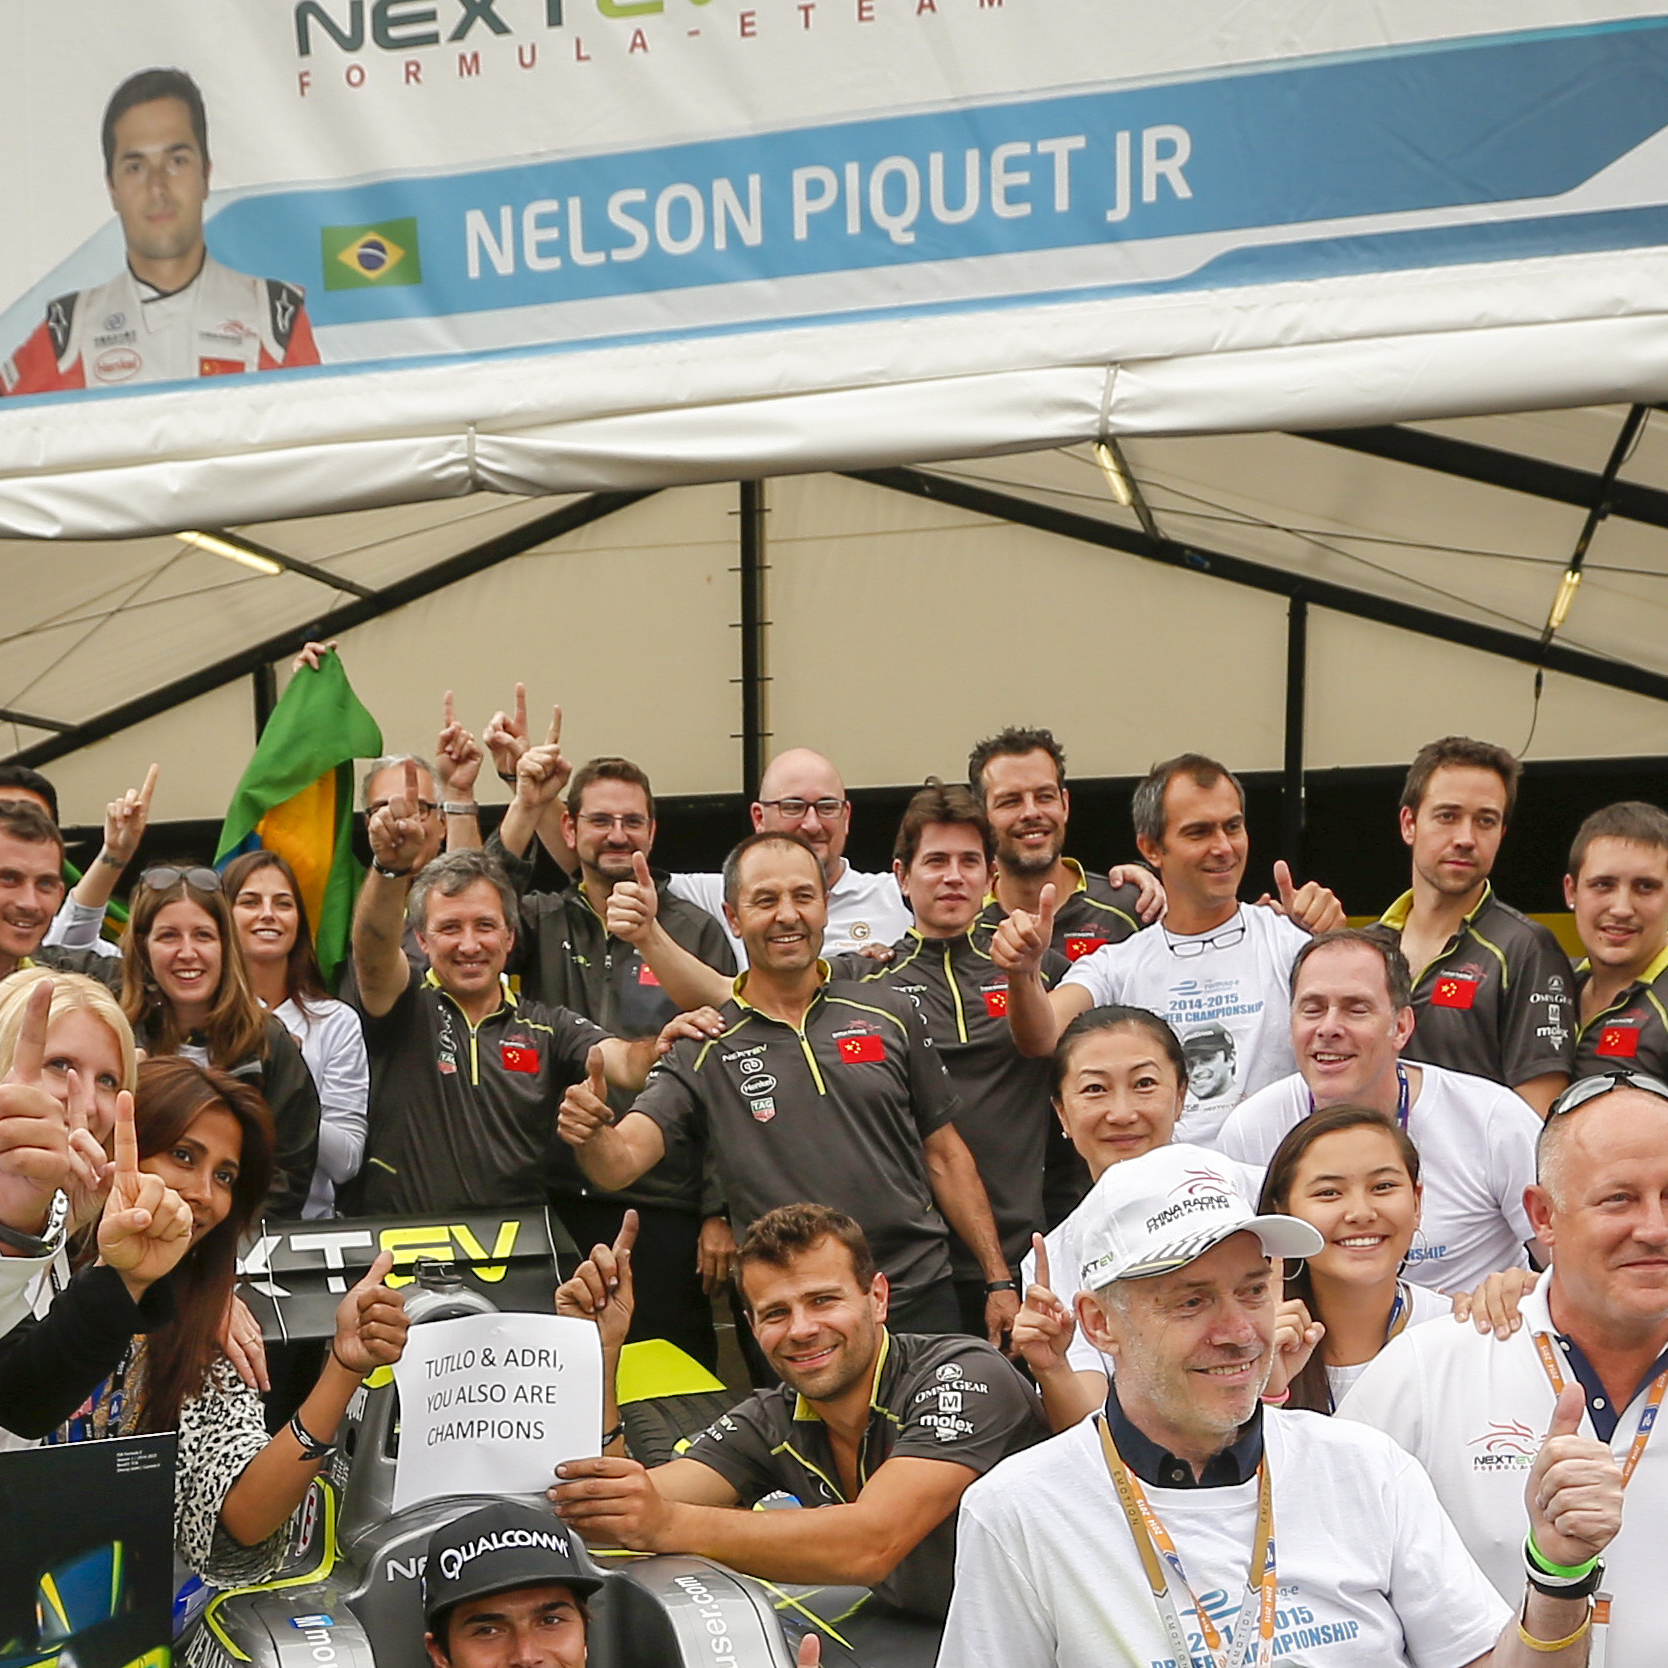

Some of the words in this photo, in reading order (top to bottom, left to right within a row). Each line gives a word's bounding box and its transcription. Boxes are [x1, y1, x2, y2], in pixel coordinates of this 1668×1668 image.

[464, 173, 763, 279] NELSON
[792, 134, 1087, 245] PIQUET
[1105, 124, 1193, 223] JR
[1168, 993, 1239, 1011] 2014-2015
[1184, 1001, 1264, 1023] CHAMPIONSHIP
[1145, 1204, 1183, 1230] CHINA
[480, 1348, 497, 1367] &
[425, 1386, 453, 1412] YOU
[453, 1383, 507, 1405] ALSO
[513, 1384, 557, 1404] ARE
[951, 1380, 990, 1396] GEAR
[425, 1419, 546, 1447] CHAMPIONS
[919, 1413, 975, 1435] molex
[437, 1526, 570, 1581] QUALCOMM
